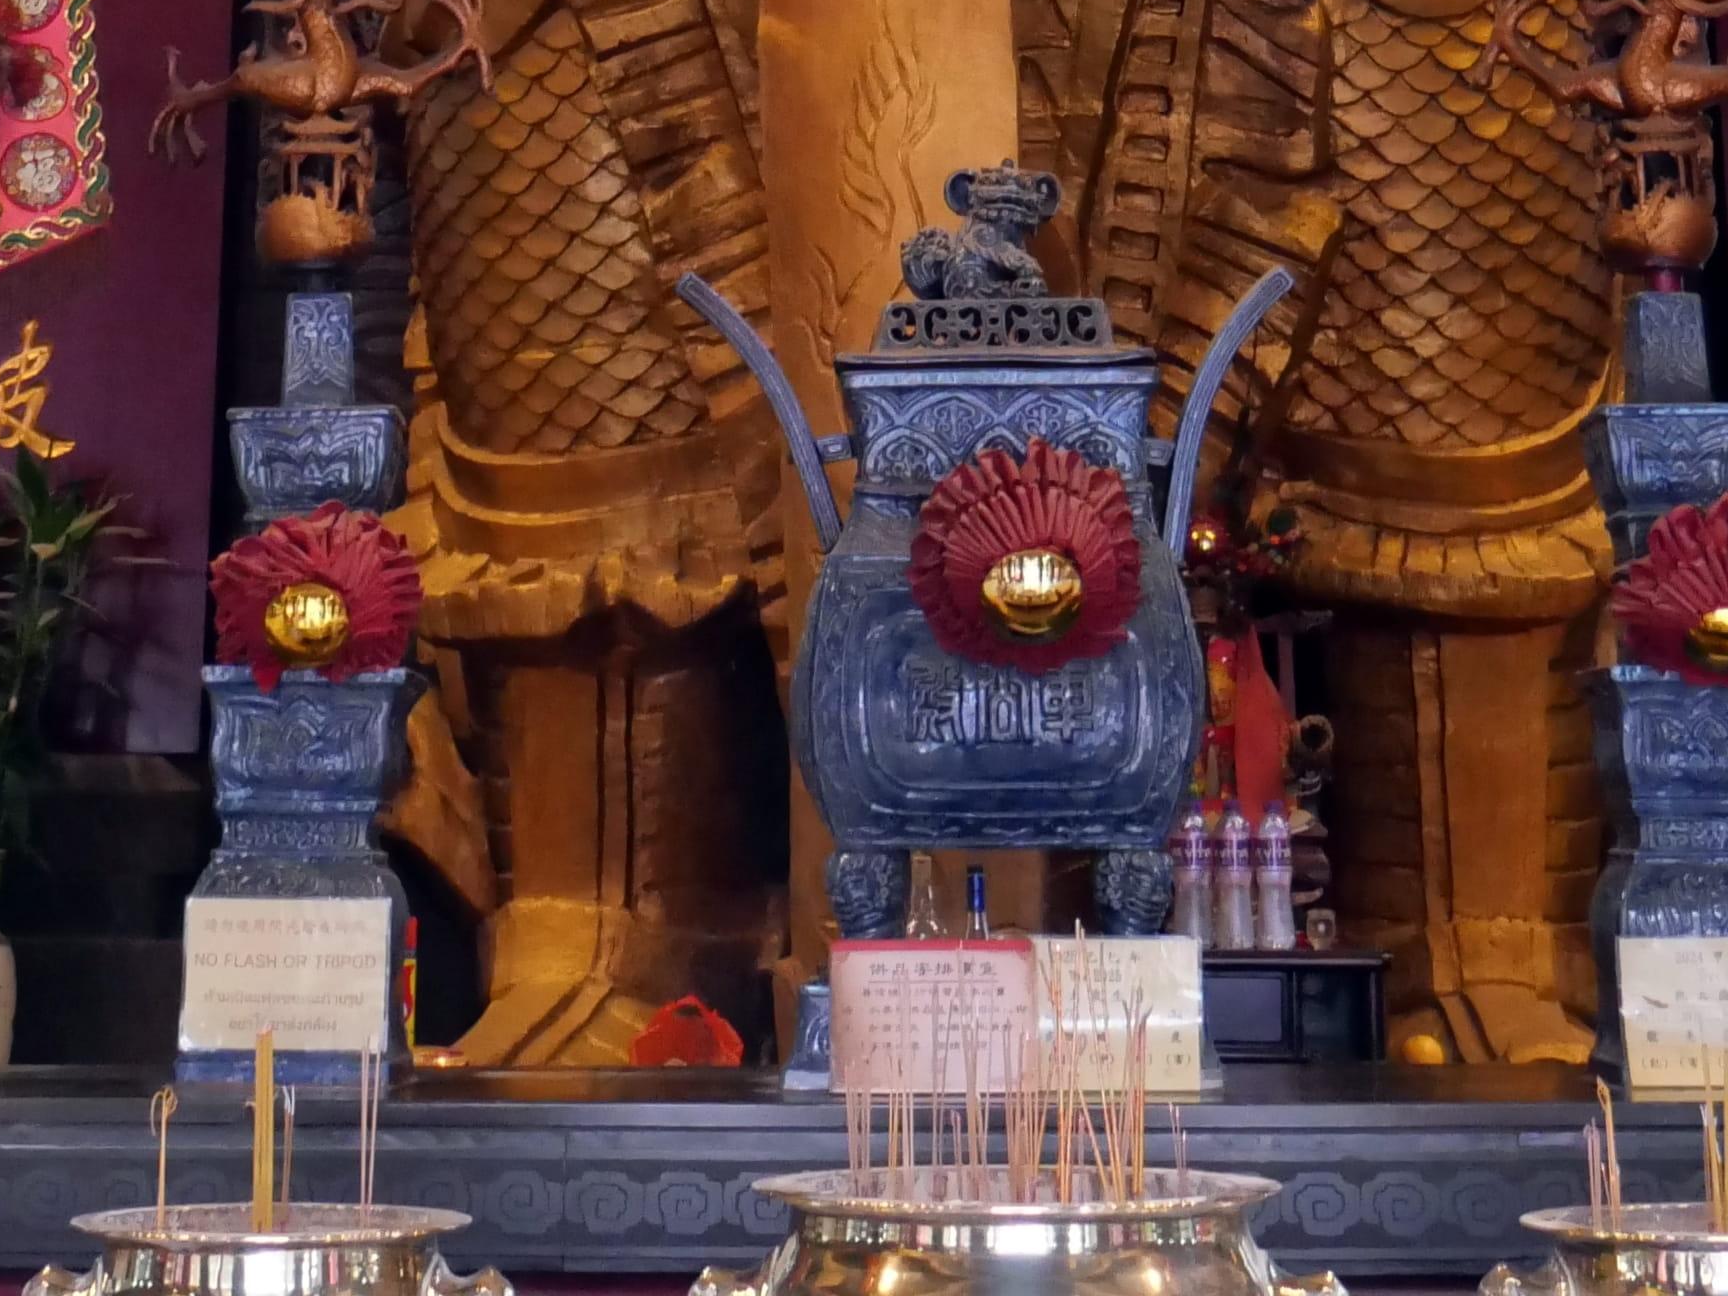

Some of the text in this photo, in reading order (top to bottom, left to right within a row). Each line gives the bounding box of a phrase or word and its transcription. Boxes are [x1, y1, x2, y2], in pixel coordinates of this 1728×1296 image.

[15, 149, 61, 194] 福
[194, 952, 377, 969] NO FLASH OR TRIPOD
